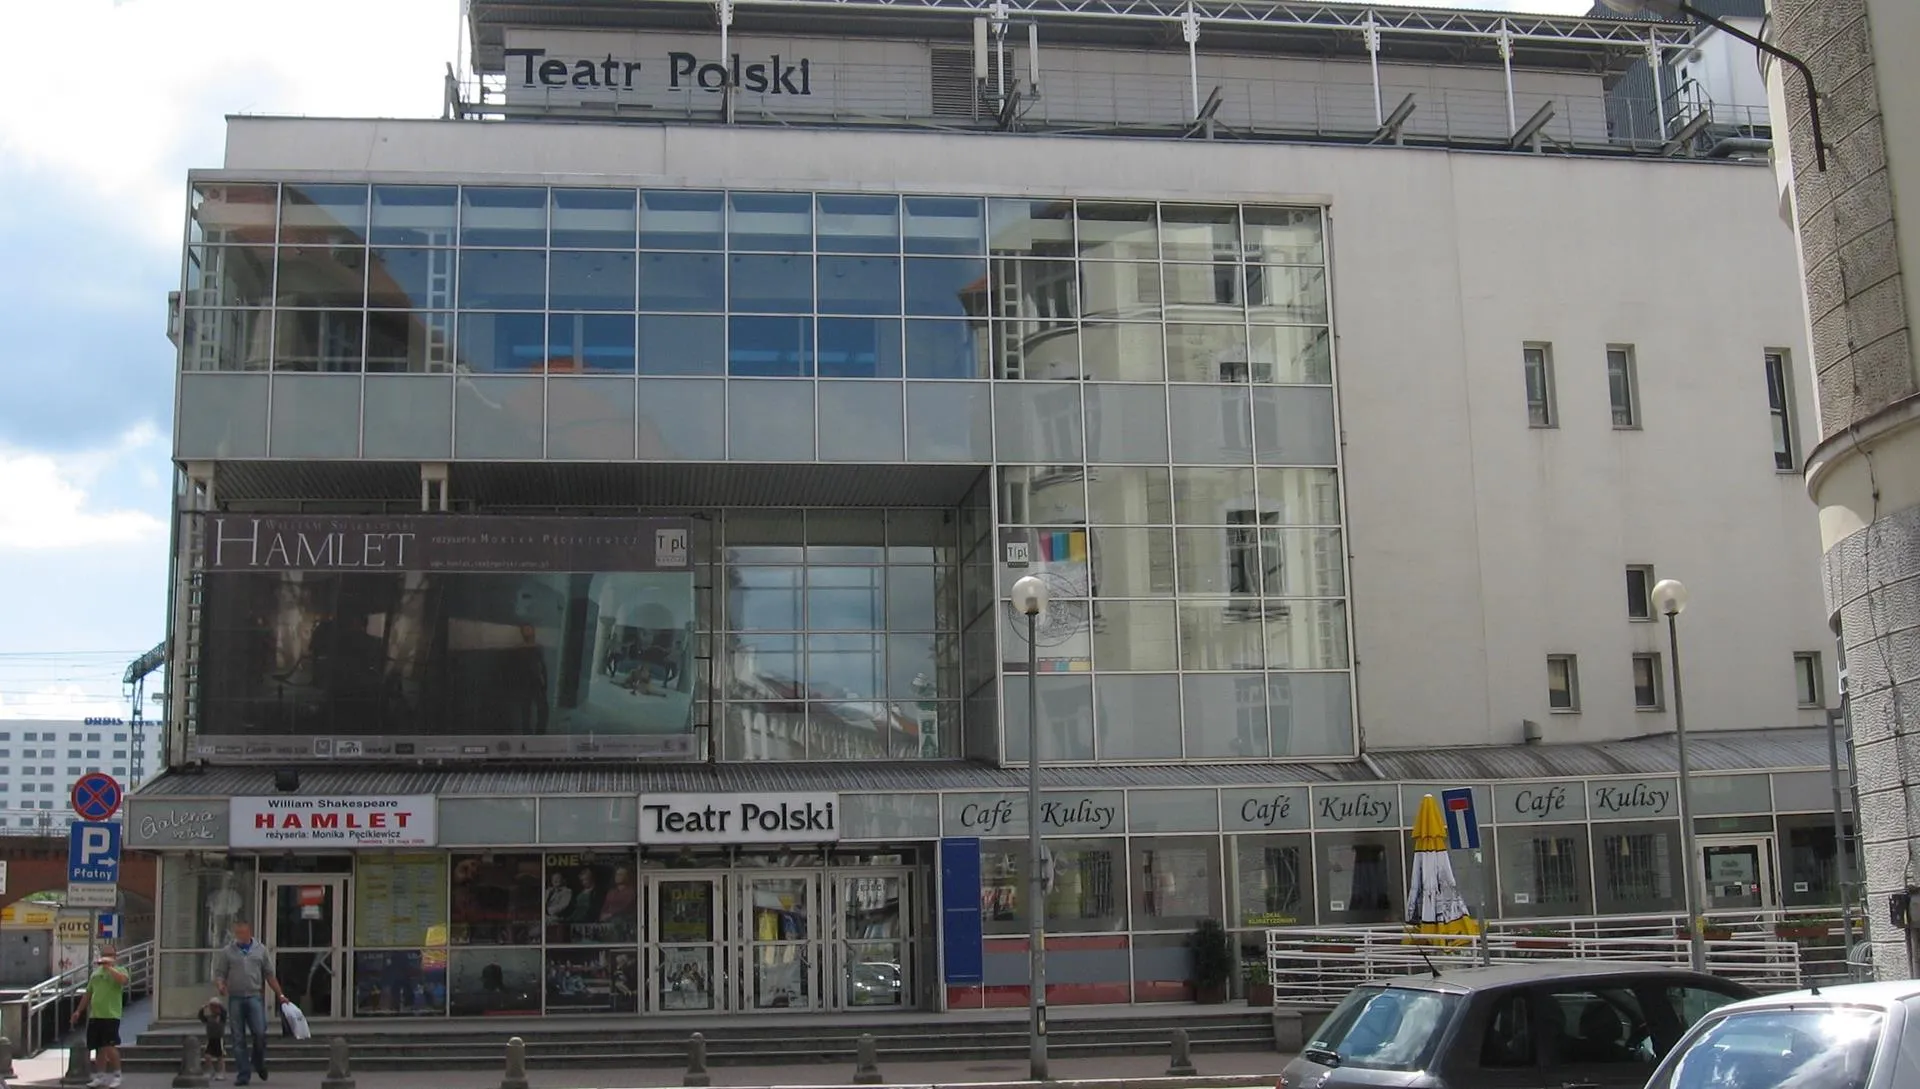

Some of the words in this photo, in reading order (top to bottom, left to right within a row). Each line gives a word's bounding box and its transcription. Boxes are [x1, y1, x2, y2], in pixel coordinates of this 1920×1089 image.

[504, 48, 641, 91] Teatr
[668, 51, 811, 95] Polski
[214, 518, 416, 566] HAMLET
[268, 799, 313, 808] William
[318, 799, 398, 809] Shakespeare
[961, 799, 1013, 832] Café
[1040, 798, 1115, 830] Kulisy
[1241, 795, 1291, 826] Café
[1319, 793, 1392, 824] Kulisy
[1515, 786, 1566, 818] Café
[1595, 783, 1669, 813] Kulisy
[255, 813, 412, 829] HAMLET
[643, 804, 731, 833] Teatr
[741, 802, 834, 832] Polski
[81, 827, 111, 865] P
[266, 830, 309, 840] reżyseria:
[312, 829, 345, 839] Monika
[349, 830, 401, 841] Pęcikiewicz
[74, 868, 113, 881] Płatny
[546, 854, 579, 867] ONE
[59, 921, 91, 932] AUTO
